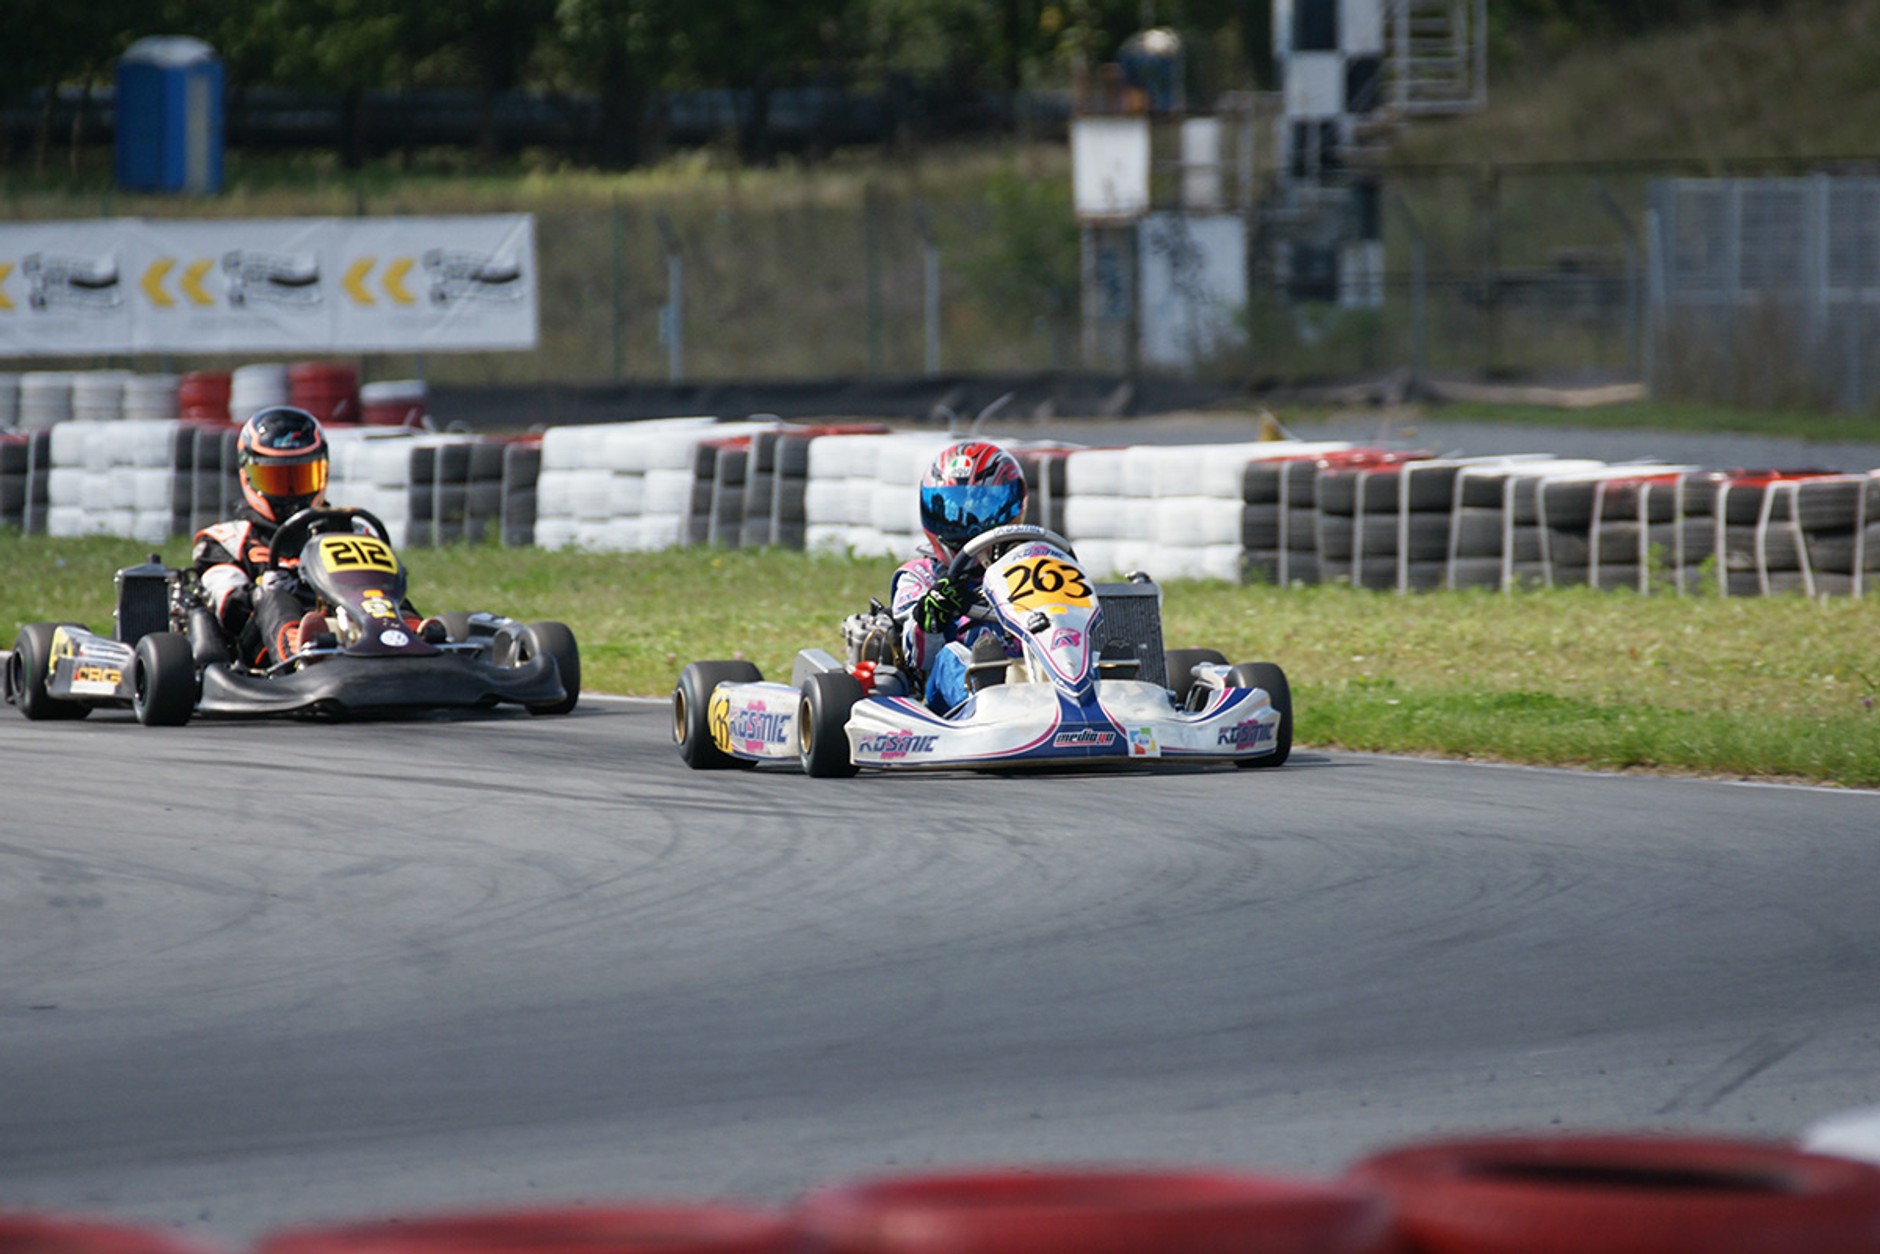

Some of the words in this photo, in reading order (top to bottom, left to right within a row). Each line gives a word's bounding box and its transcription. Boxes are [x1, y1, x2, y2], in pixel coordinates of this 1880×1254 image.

[324, 540, 394, 569] 212
[1003, 559, 1093, 603] 263
[78, 666, 123, 686] CRG
[730, 709, 791, 743] KOSMIC
[1217, 722, 1275, 745] KOSMIC
[859, 734, 940, 753] KOSMIC
